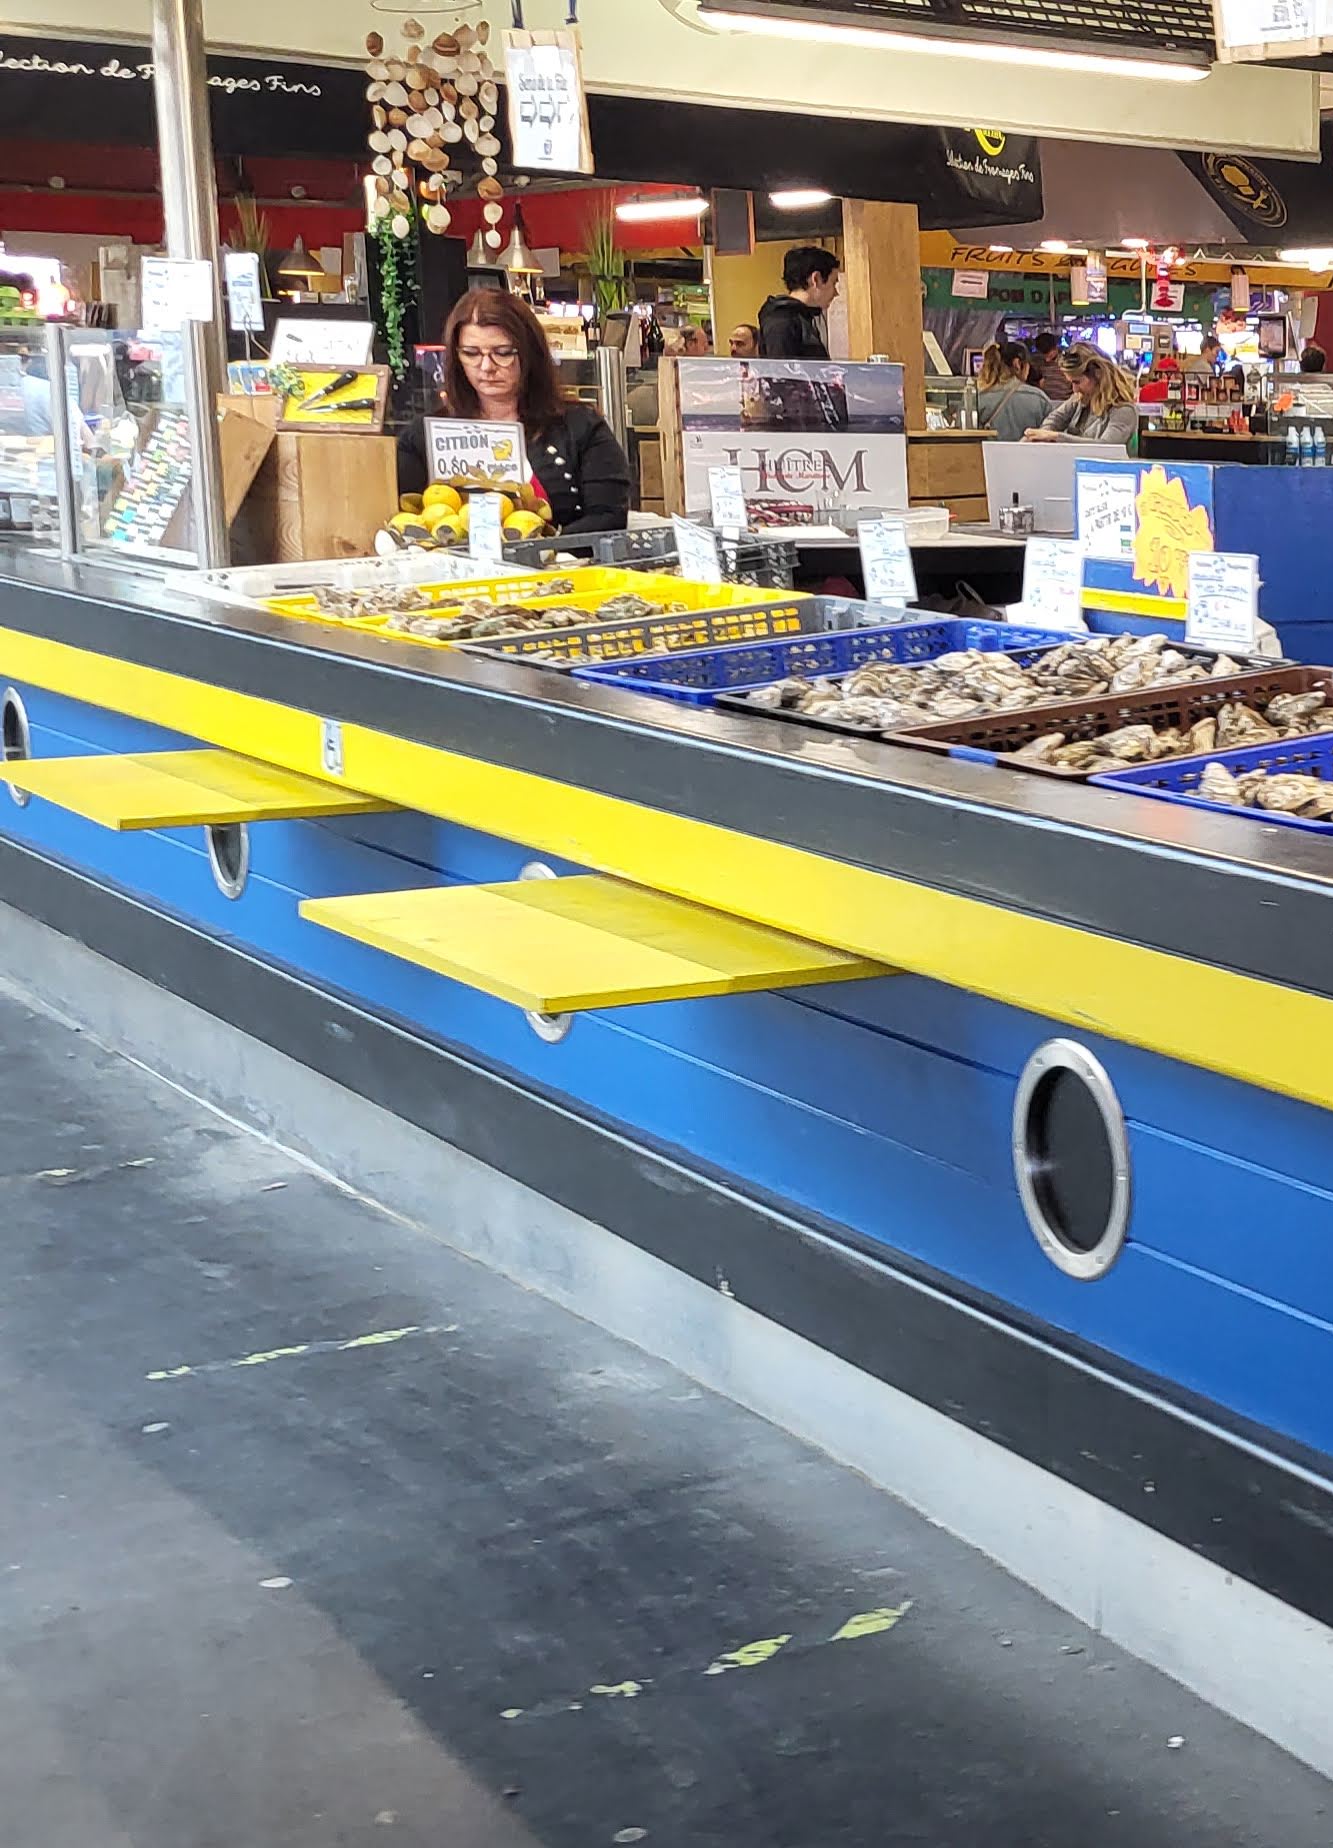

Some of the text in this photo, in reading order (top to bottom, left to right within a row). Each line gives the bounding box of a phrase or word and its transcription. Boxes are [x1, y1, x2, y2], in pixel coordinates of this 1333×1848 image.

[100, 59, 136, 79] de
[265, 75, 321, 96] Fins
[951, 246, 1044, 266] FRUITS
[435, 434, 489, 451] CITRON
[722, 448, 871, 493] HCM
